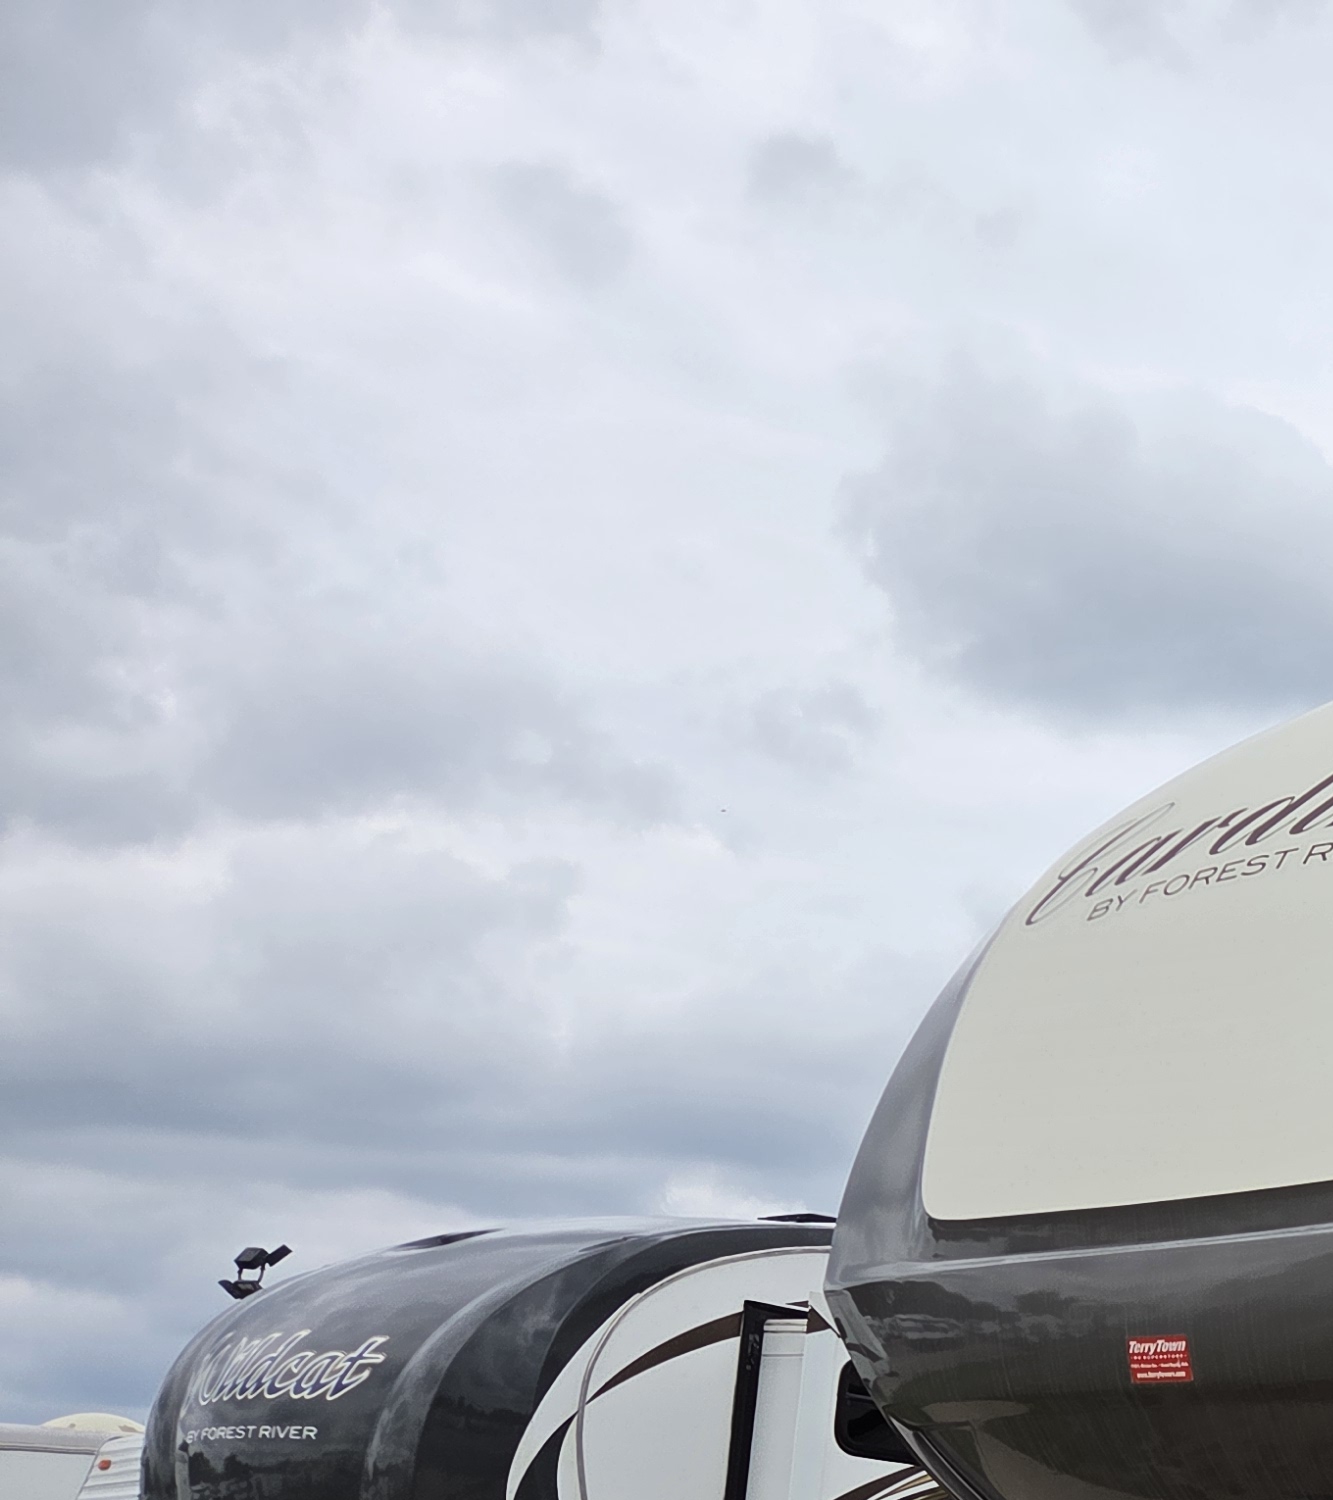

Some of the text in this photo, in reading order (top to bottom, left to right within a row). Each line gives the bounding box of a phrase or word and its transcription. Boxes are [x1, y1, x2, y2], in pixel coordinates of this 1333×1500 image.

[1087, 889, 1138, 922] BY
[1139, 847, 1299, 905] FOREST
[200, 1425, 257, 1441] FOREST
[258, 1425, 319, 1440] RIVER
